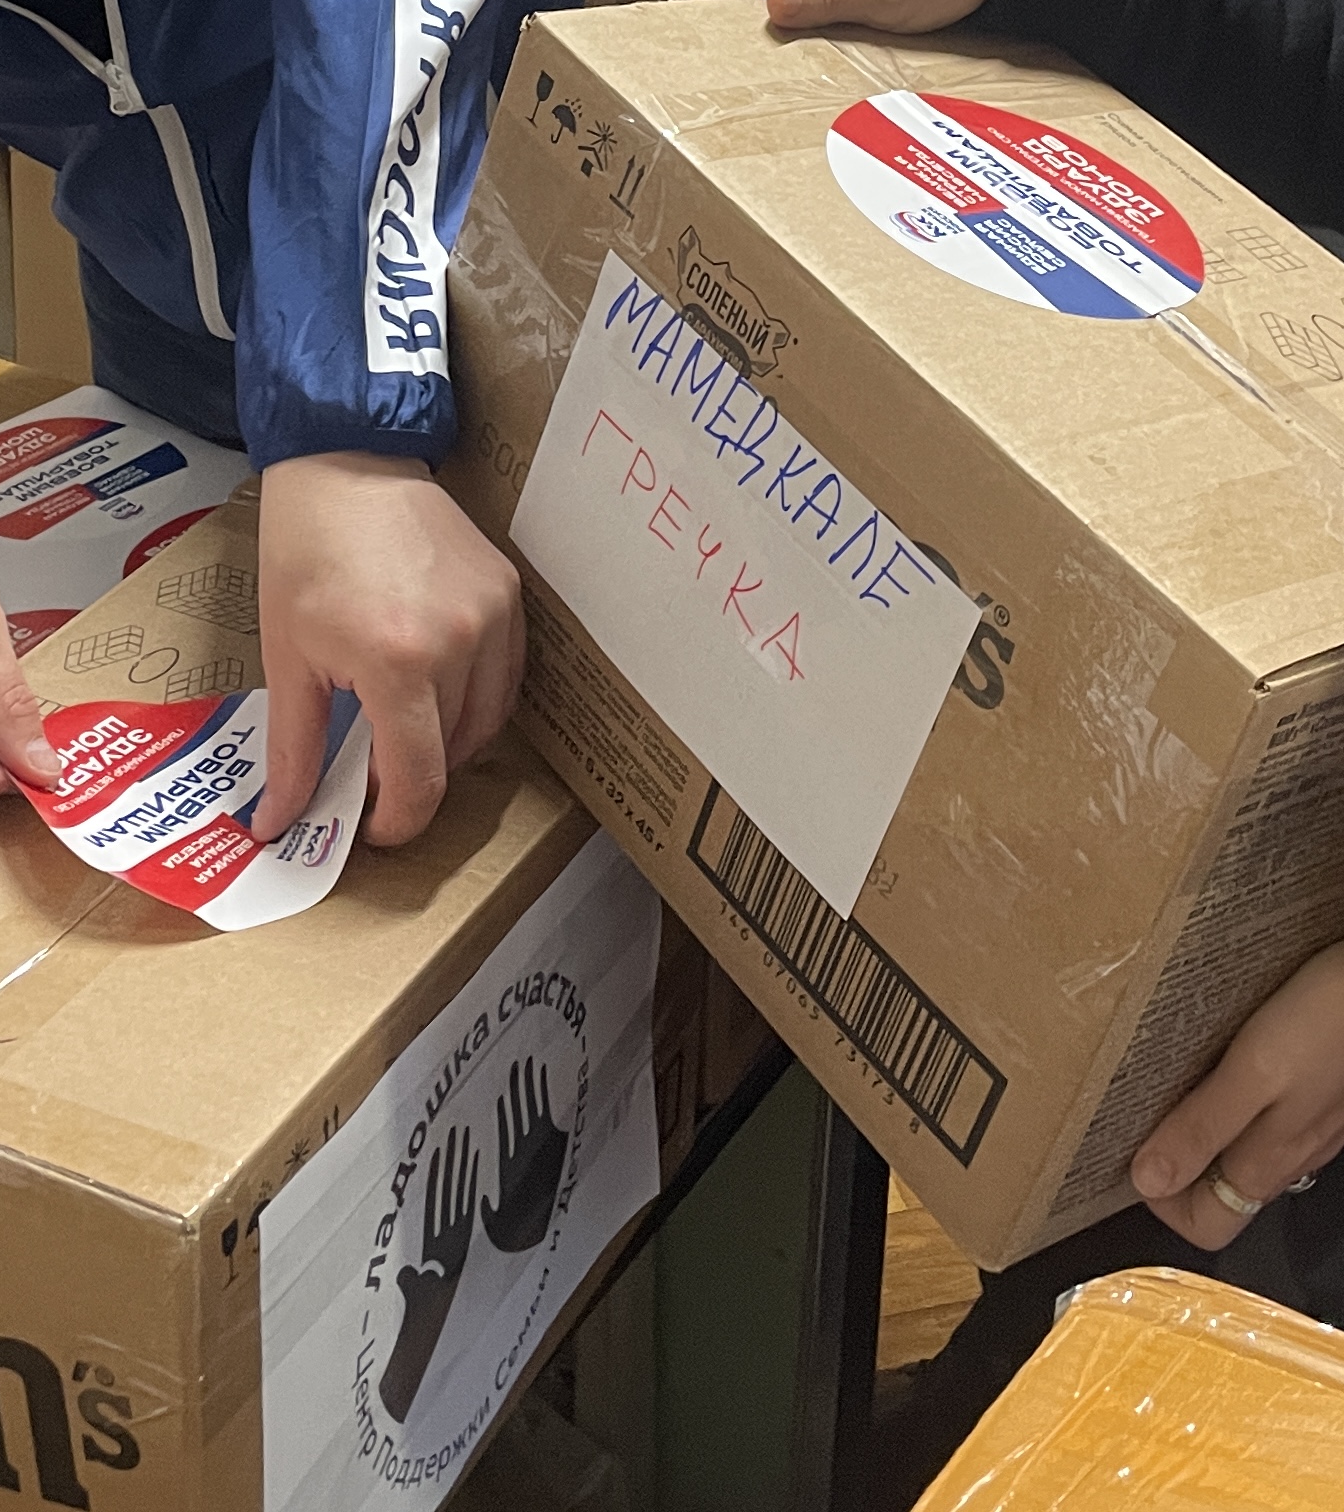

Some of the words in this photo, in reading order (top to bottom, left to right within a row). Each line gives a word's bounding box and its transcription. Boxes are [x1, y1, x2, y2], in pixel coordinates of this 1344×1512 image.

[894, 155, 967, 208] ВЕЛИКАЯ
[907, 144, 987, 202] НАВСЕГДА
[915, 161, 976, 204] СТРАНА
[933, 121, 1144, 274] ТОВАРИЩАМ
[945, 148, 1098, 250] БОЕВЫМ
[1024, 138, 1151, 226] ЭДУАРД
[1041, 134, 1164, 218] ШОНОВ
[973, 223, 1037, 271] ЕДИНАЯ
[984, 220, 1049, 275] РОССИЯ
[994, 218, 1067, 269] СЕЙЧАС
[686, 263, 771, 355] СОЛЕНЫЙ
[15, 454, 111, 502] БОЕВЫМ
[582, 409, 806, 680] ГРЕЧКА
[55, 715, 129, 769] ШОН
[83, 726, 256, 848] ТОВАРИЩАМ
[134, 760, 256, 844] БОЕВЫМ
[161, 827, 228, 869] НАВСЕГДА
[189, 833, 241, 867] СТРАНА
[193, 838, 254, 884] ВЕЛИКАЯ
[498, 971, 587, 1038] счастья
[763, 950, 821, 1021] 07065
[836, 1031, 895, 1106] 73173
[909, 1117, 920, 1134] 8
[351, 1337, 378, 1459] Центр
[372, 1396, 490, 1490] Поддержки
